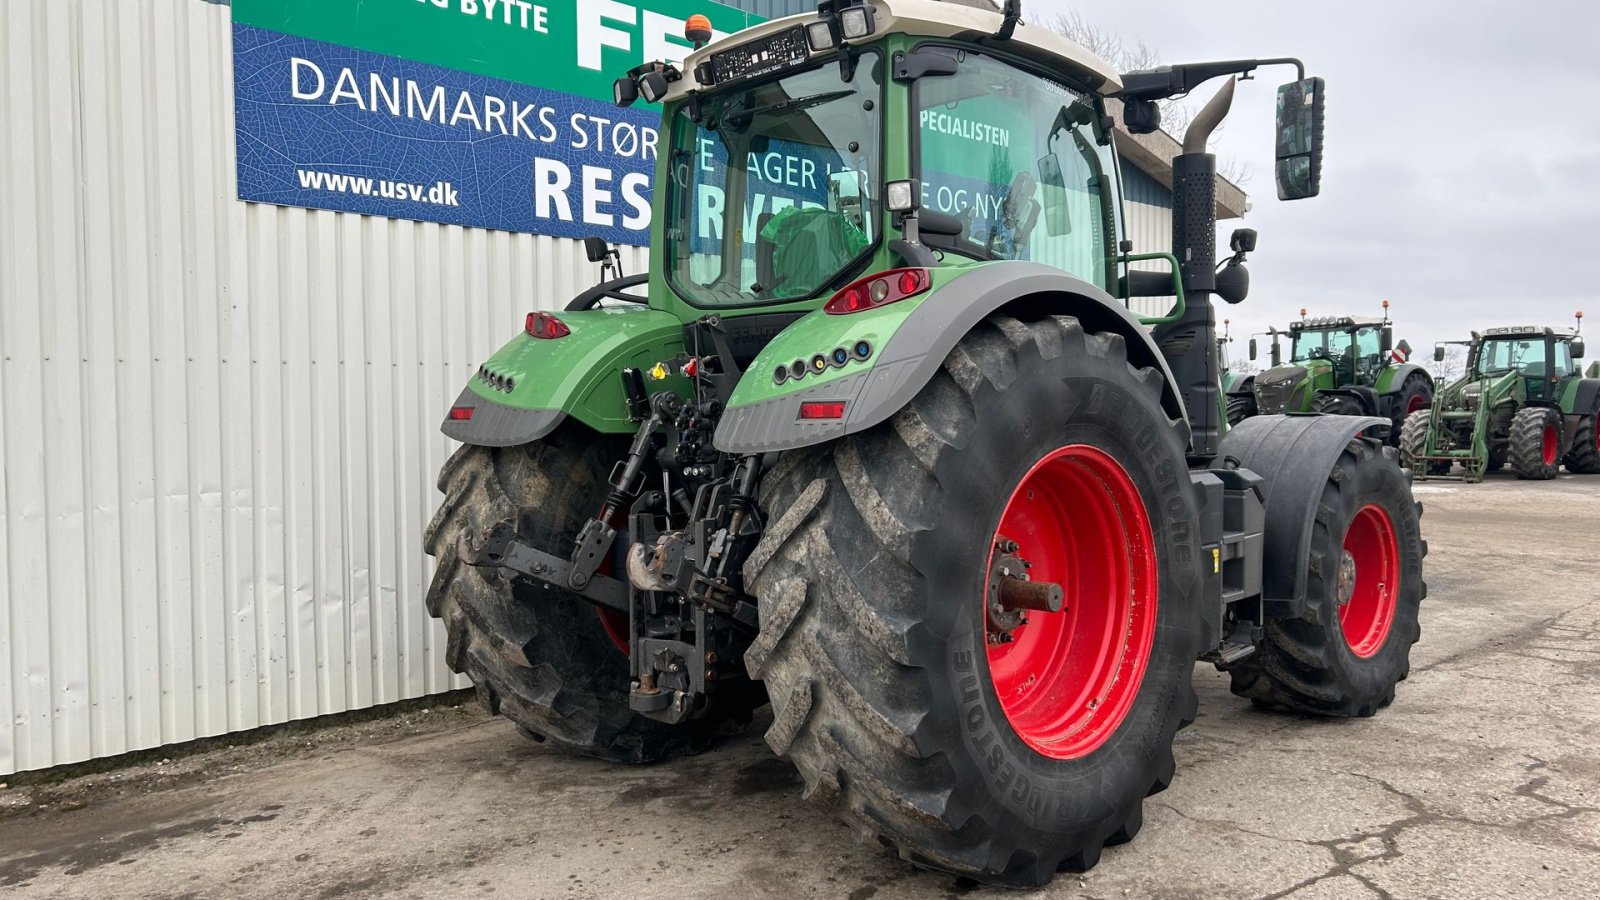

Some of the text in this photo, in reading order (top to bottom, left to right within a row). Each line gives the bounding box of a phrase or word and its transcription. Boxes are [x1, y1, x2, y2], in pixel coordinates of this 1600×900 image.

[576, 0, 731, 71] FE
[290, 57, 557, 143] DANMARKS
[747, 152, 817, 190] AGER
[937, 186, 968, 213] OG
[975, 192, 1007, 221] NY
[920, 110, 1009, 147] PECIALISTEN
[298, 169, 459, 208] www.usv.dk
